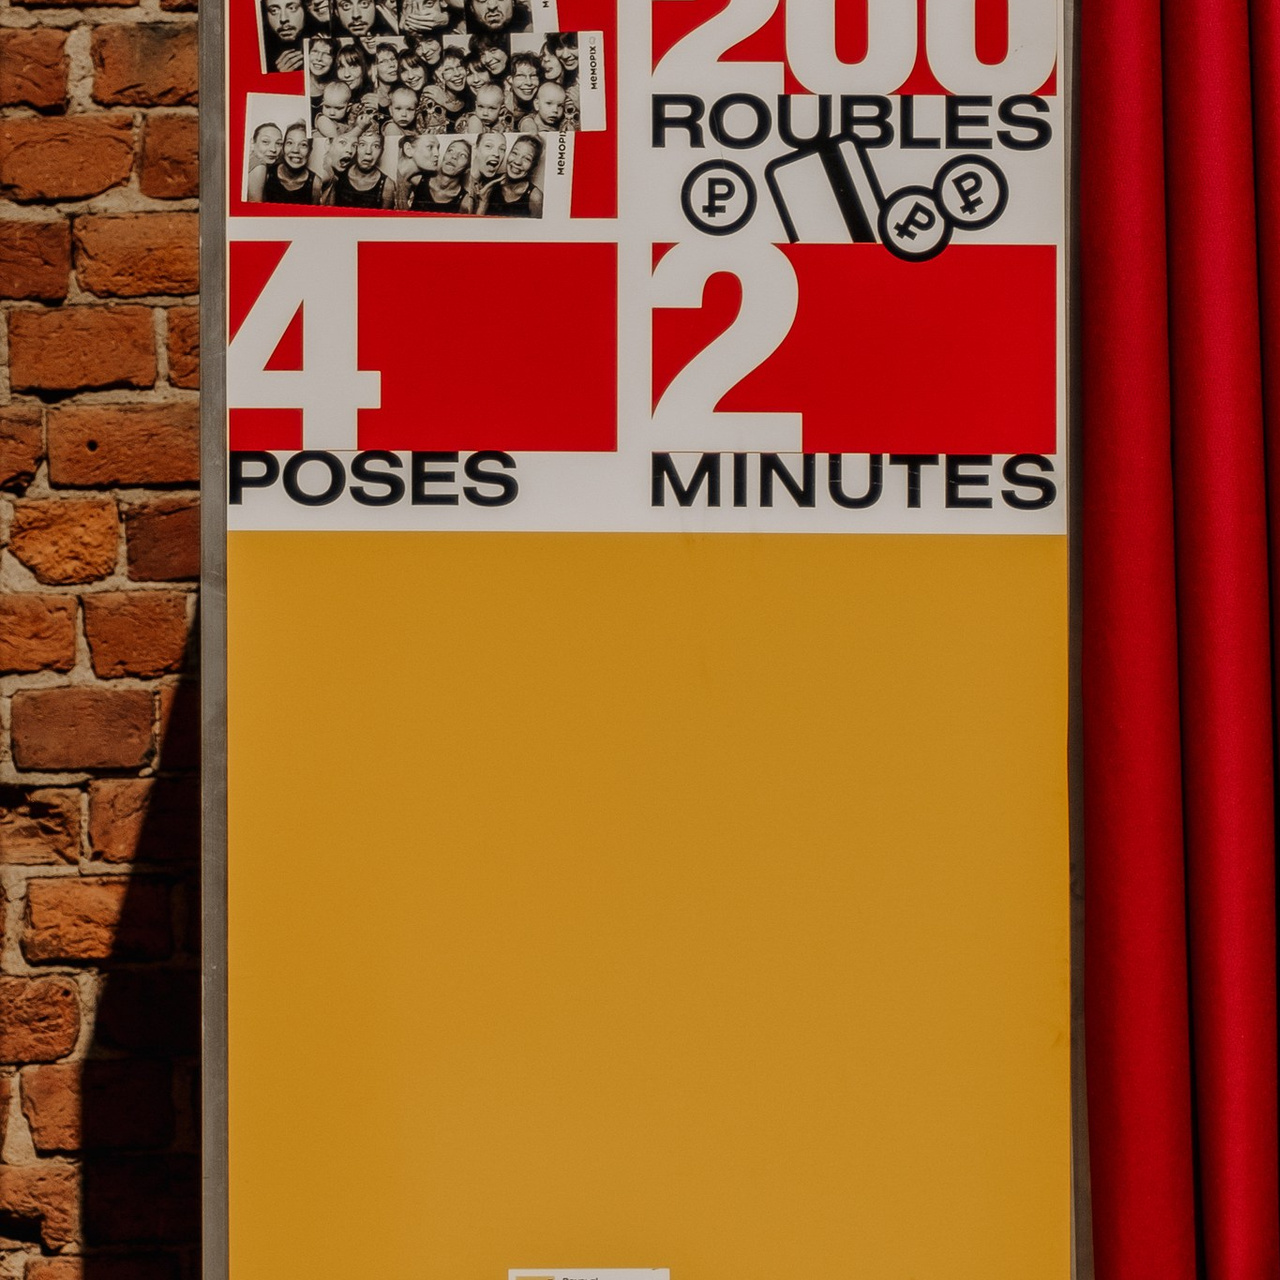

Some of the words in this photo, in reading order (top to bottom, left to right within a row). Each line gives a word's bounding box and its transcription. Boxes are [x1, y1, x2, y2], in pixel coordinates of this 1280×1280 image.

[651, 93, 1053, 151] ROUBLES
[228, 240, 382, 451] 4
[651, 241, 803, 454] 2
[228, 450, 519, 507] POSES
[651, 453, 1057, 511] MINUTES
